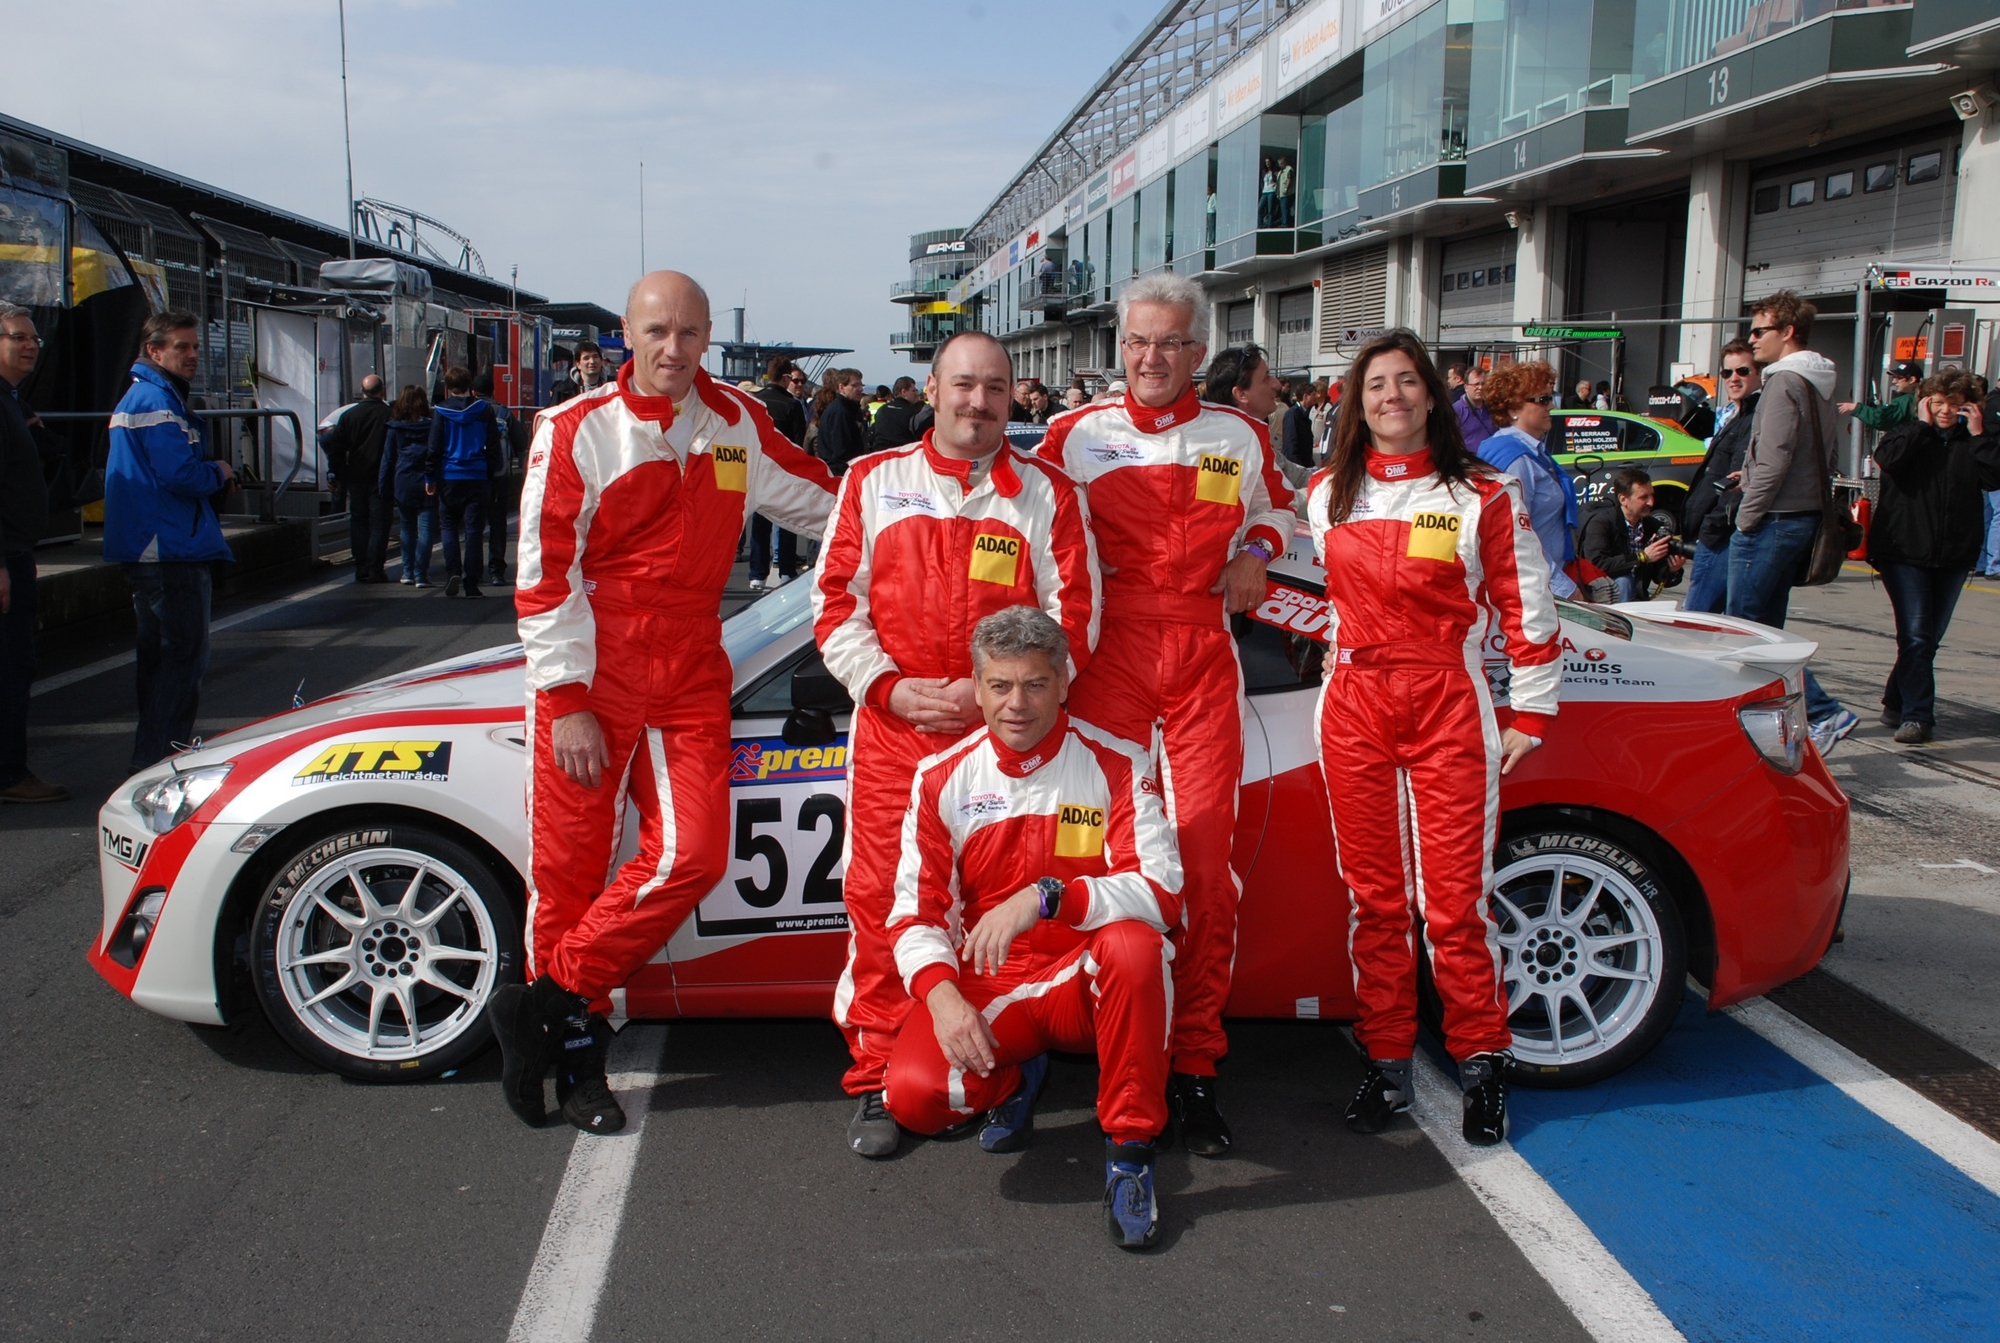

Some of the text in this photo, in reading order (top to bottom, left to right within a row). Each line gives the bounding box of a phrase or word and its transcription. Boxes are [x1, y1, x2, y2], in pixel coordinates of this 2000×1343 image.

[1292, 42, 1302, 63] Wir
[1302, 31, 1319, 57] leben
[1708, 66, 1729, 106] 13
[1227, 91, 1236, 109] Wir
[1235, 84, 1247, 106] leben
[1513, 140, 1527, 170] 14
[1391, 186, 1400, 210] 15
[937, 241, 966, 252] AMG
[1914, 277, 1972, 286] GAZOO
[1154, 414, 1175, 427] OMP
[715, 446, 746, 464] ADAC
[1201, 456, 1239, 476] ADAC
[1385, 465, 1407, 476] OMP
[897, 491, 923, 499] TOYOTA
[1414, 514, 1459, 532] ADAC
[975, 536, 1018, 556] ADAC
[1611, 677, 1656, 687] Team
[295, 740, 442, 778] ATS
[1020, 755, 1042, 771] OMP
[323, 770, 448, 782] Leichtmetallräder
[971, 793, 997, 802] TOYOTA
[1060, 807, 1102, 827] ADAC
[102, 826, 132, 857] TMG
[734, 793, 847, 908] 52
[286, 830, 389, 886] MICHELIN
[1538, 834, 1644, 877] MICHELIN
